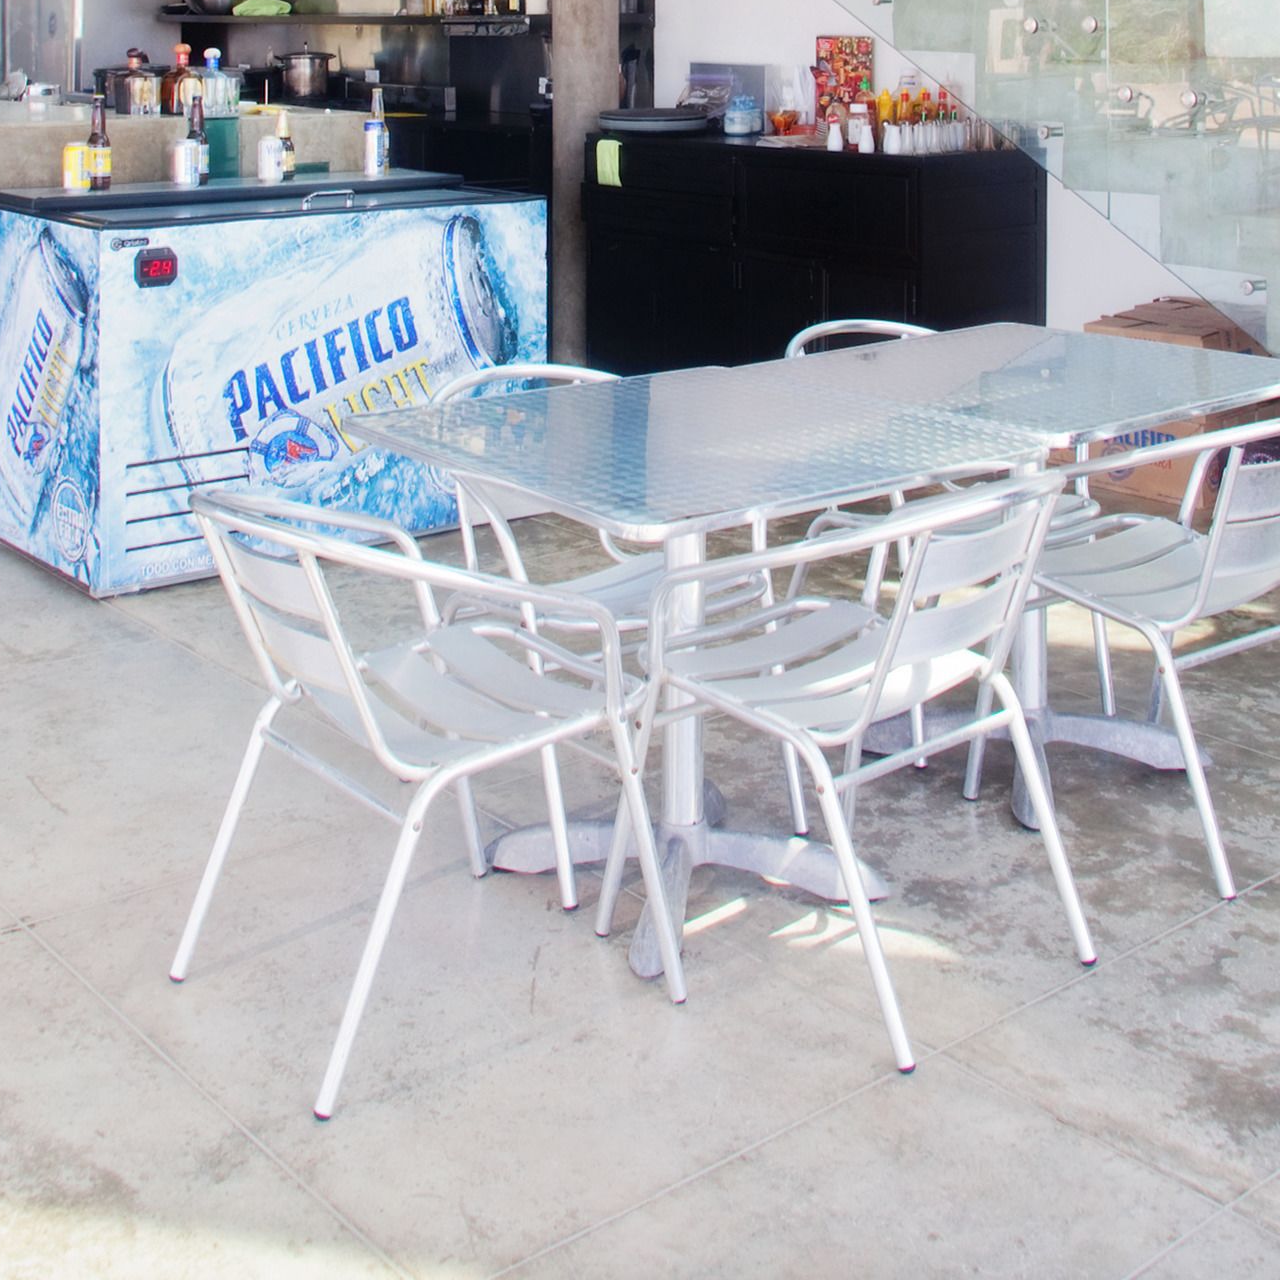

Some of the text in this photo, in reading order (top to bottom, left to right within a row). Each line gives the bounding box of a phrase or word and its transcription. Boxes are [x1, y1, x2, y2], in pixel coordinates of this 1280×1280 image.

[276, 293, 354, 341] CERVEZA
[6, 308, 53, 458] PACIFICO
[37, 342, 70, 430] LIGHT
[222, 296, 418, 442] PACIFICO
[141, 563, 169, 577] TODO
[173, 559, 195, 570] CON
